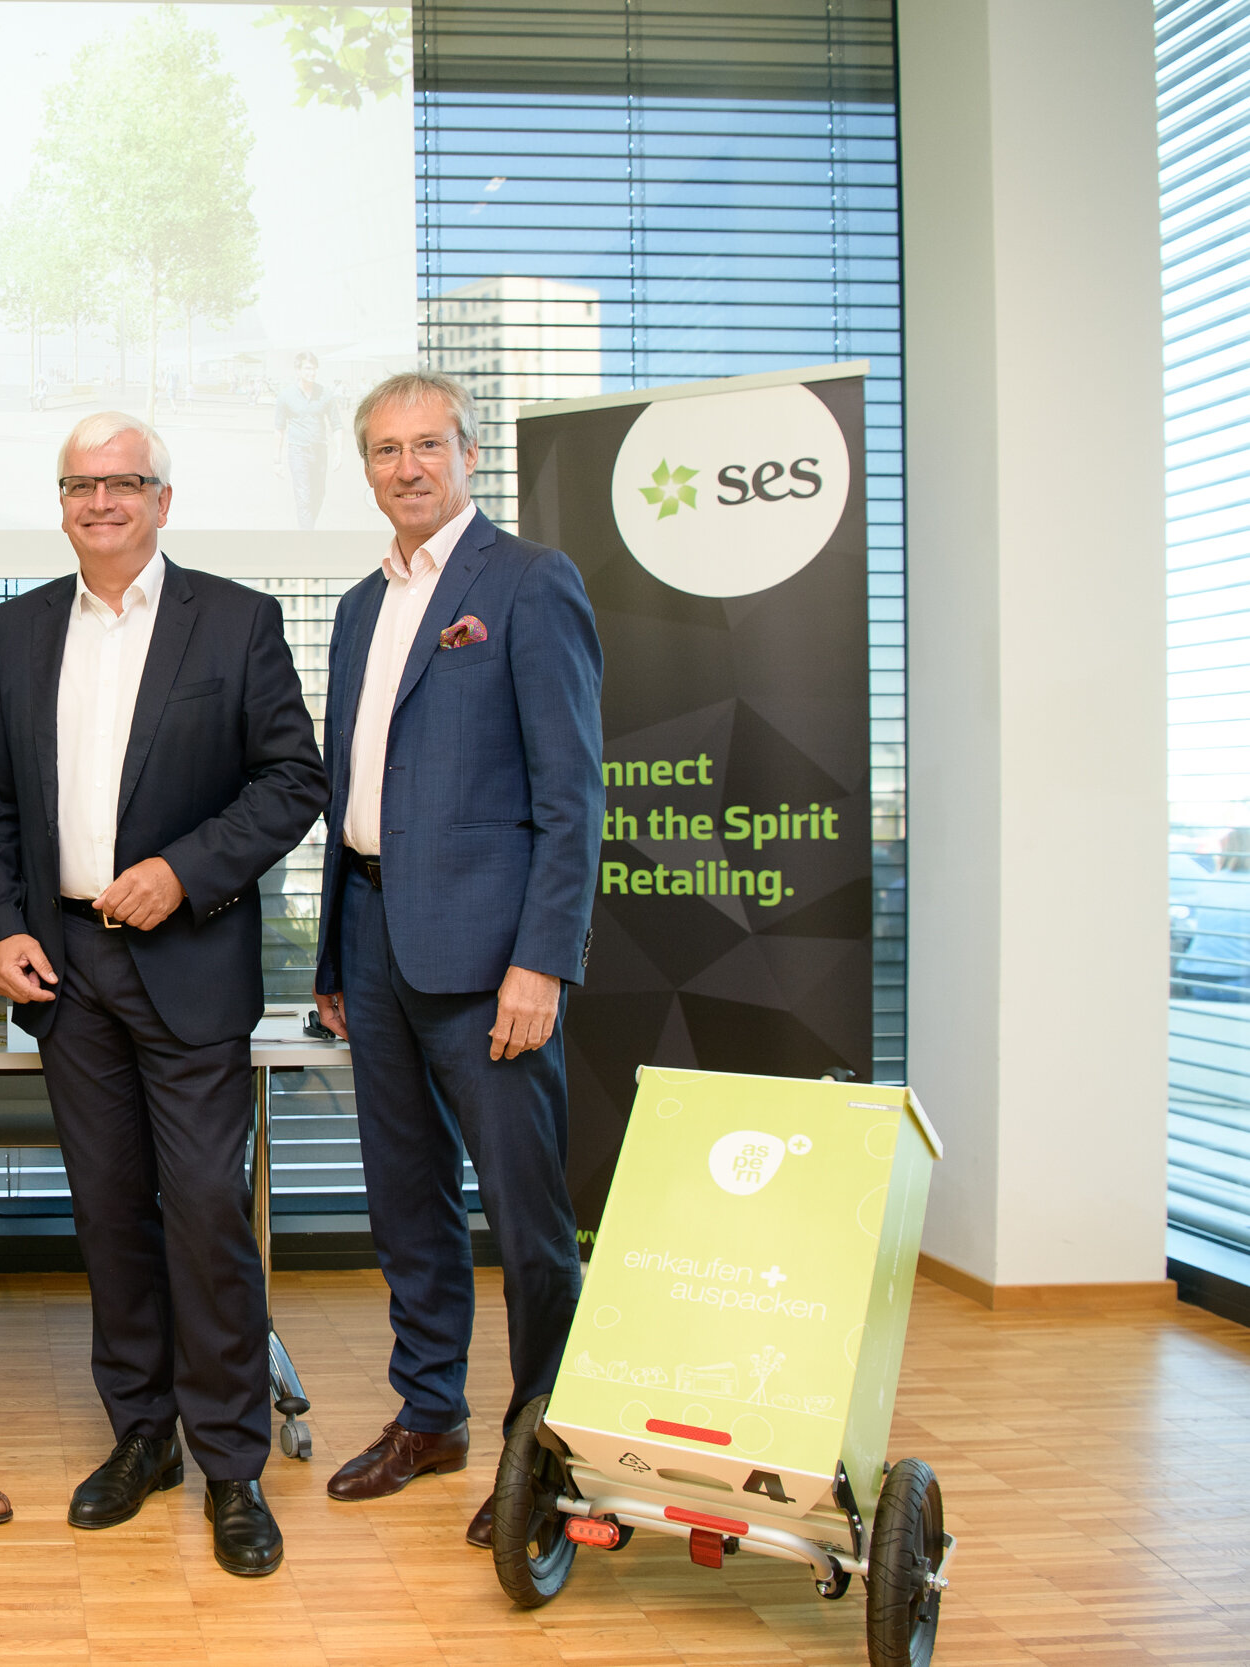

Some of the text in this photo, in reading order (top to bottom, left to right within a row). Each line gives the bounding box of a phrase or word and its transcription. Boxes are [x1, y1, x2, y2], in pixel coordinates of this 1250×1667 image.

[716, 457, 823, 506] ses
[602, 753, 713, 787] nnect
[647, 806, 714, 841] the
[724, 803, 839, 850] Spirit
[602, 860, 795, 907] Retailing.
[732, 1155, 763, 1172] pe
[741, 1143, 770, 1159] as
[623, 1247, 753, 1285] einkaufen
[670, 1281, 827, 1322] auspacken
